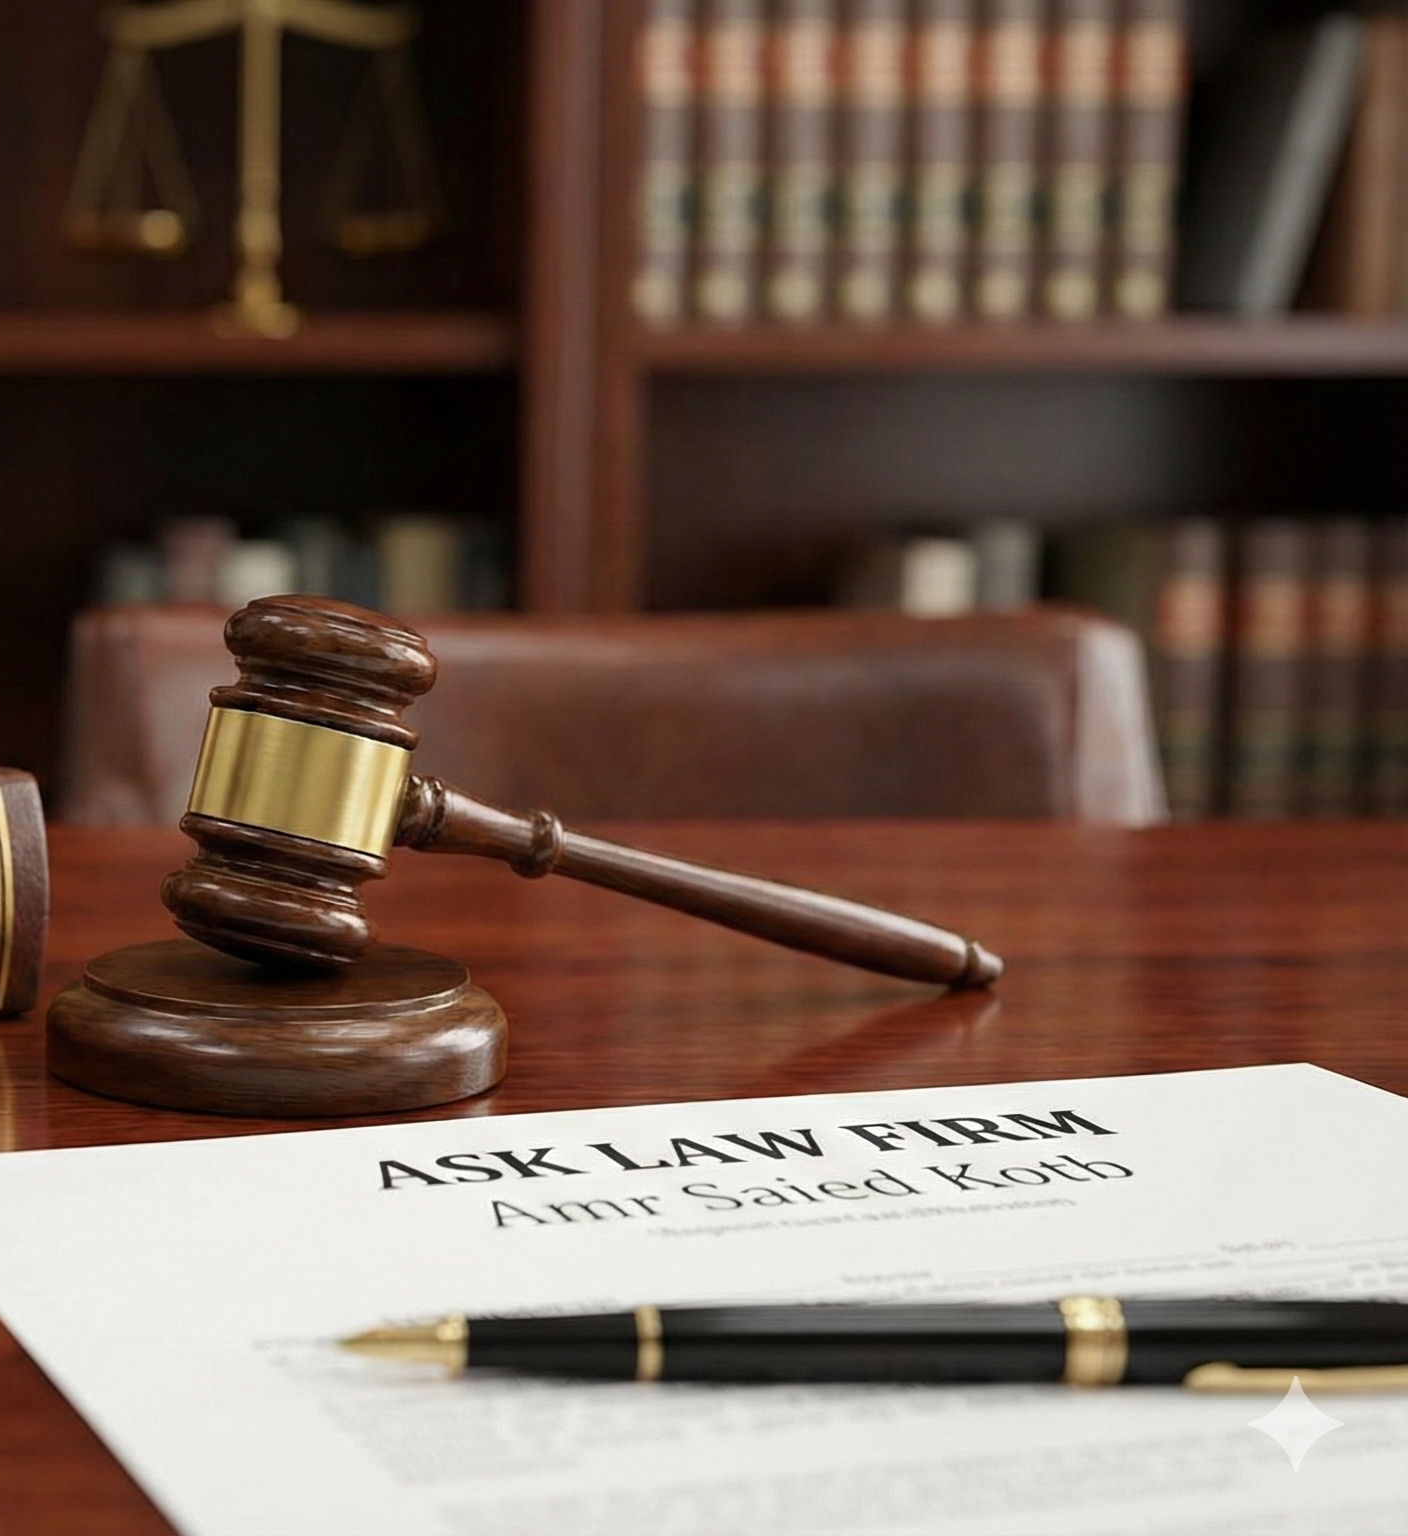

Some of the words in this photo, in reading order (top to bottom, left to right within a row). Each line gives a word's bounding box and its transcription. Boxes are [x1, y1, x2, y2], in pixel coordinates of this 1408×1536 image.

[378, 1146, 588, 1190] ASK
[586, 1128, 825, 1171] LAW
[839, 1110, 1118, 1152] FIRM
[491, 1195, 660, 1228] Amr
[681, 1169, 922, 1211] Saied
[924, 1154, 1134, 1192] Kotb
